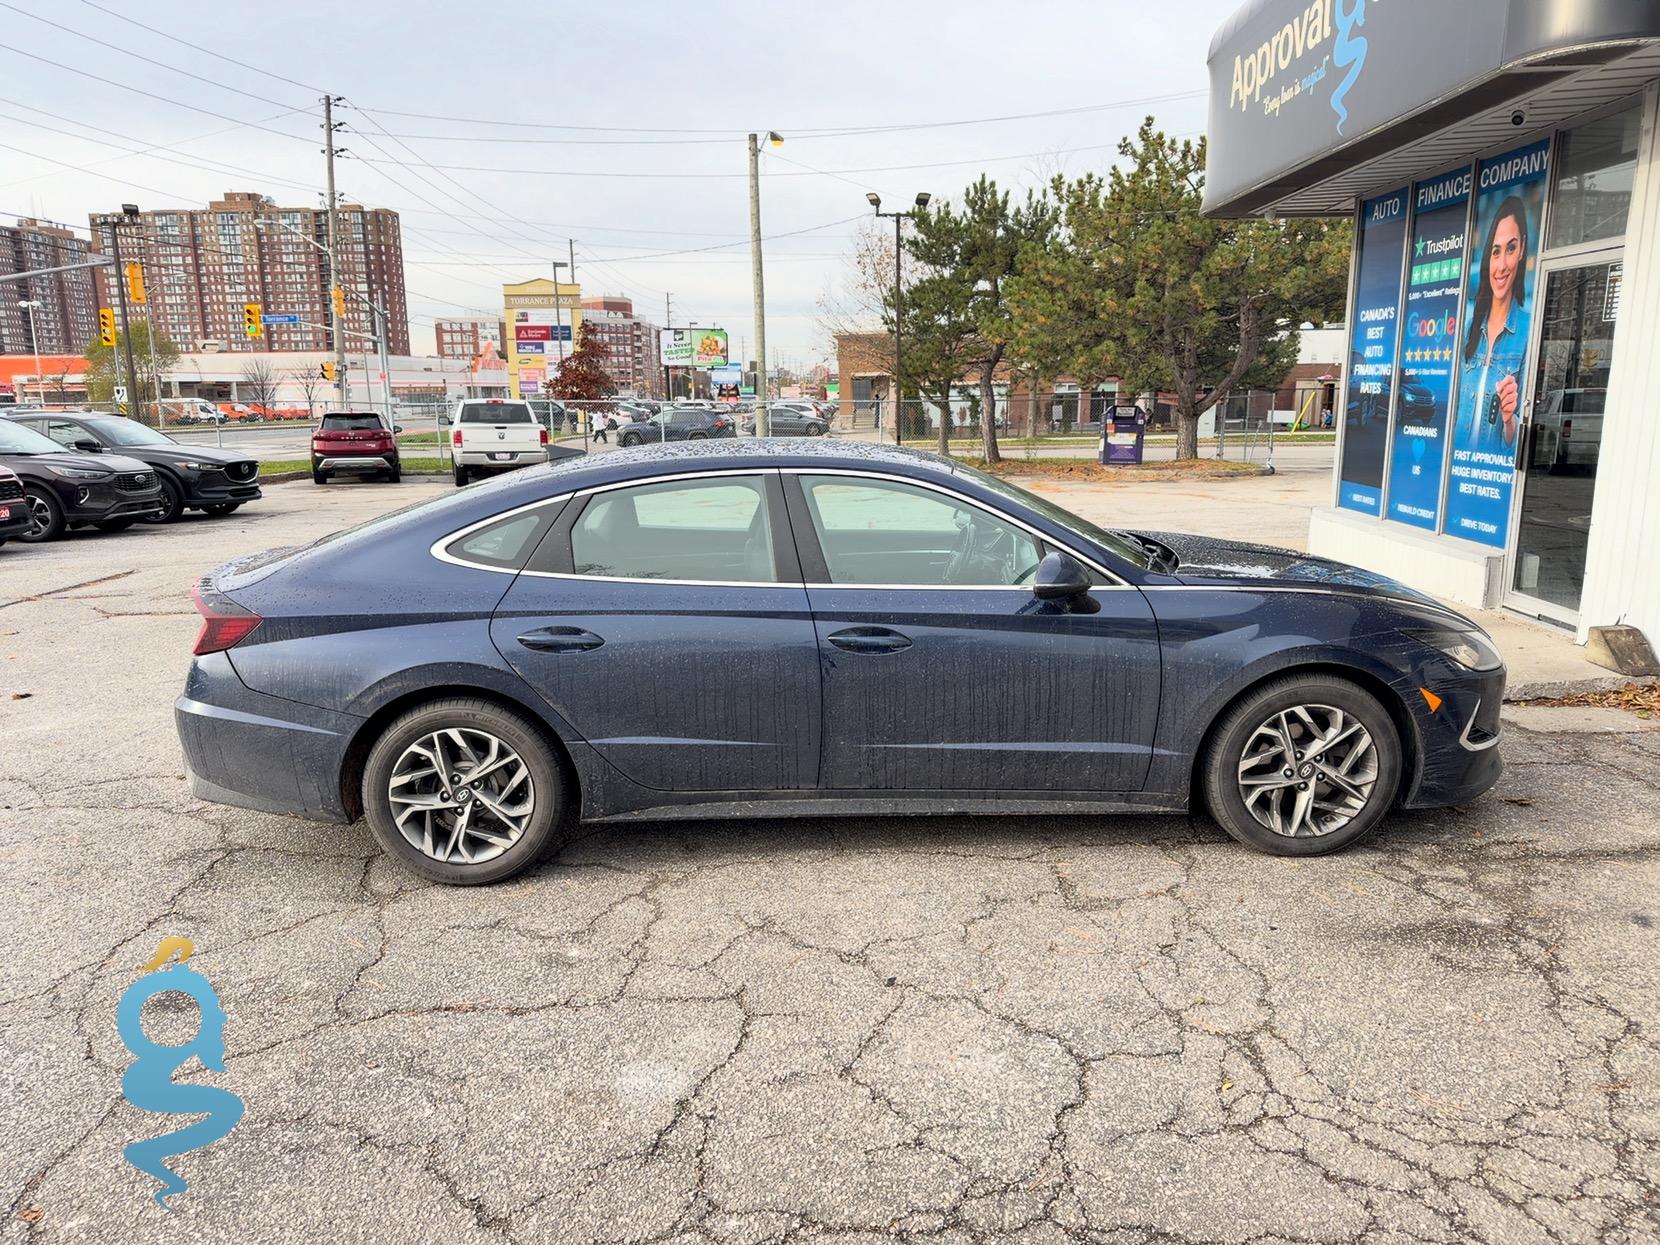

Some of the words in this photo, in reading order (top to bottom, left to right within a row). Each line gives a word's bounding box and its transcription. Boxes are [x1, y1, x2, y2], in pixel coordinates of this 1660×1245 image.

[1230, 0, 1331, 112] Approval
[1480, 150, 1550, 188] COMPANY
[1417, 174, 1471, 207] FINANCE
[1373, 198, 1400, 221] AUTO
[1427, 234, 1463, 255] Trustpilot
[511, 297, 550, 305] TORRANCE
[1360, 306, 1395, 322] CANADA'S
[1366, 327, 1384, 339] BEST
[1407, 308, 1456, 343] Google
[1365, 346, 1383, 358] AUTO
[1354, 363, 1392, 377] FINANCING
[1360, 382, 1382, 394] RATES
[1403, 425, 1438, 438] CANADIANS
[1454, 450, 1471, 460] FAST
[1470, 452, 1515, 467] APPROVALS.
[1412, 465, 1421, 475] US
[1451, 465, 1471, 478] HUGE
[1459, 482, 1477, 495] BEST
[1476, 485, 1501, 499] RATES.
[1397, 504, 1416, 515] REBUILD
[1416, 508, 1435, 519] CREDIT
[1461, 518, 1478, 530] DRIVE
[1478, 521, 1498, 534] TODAY
